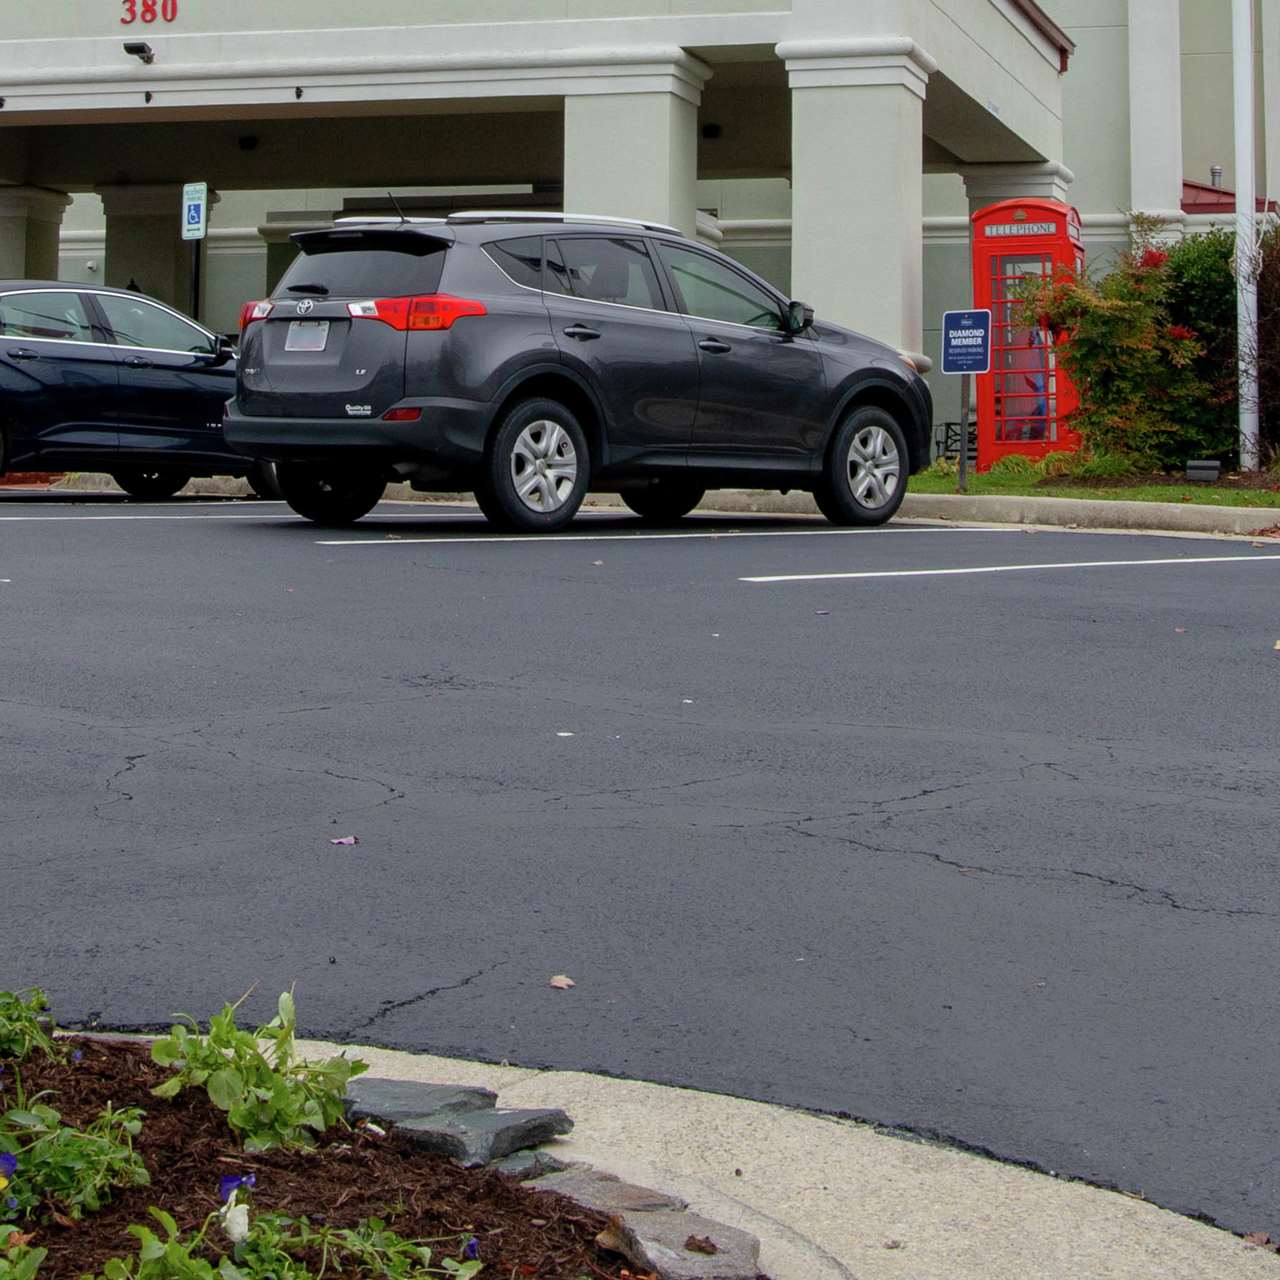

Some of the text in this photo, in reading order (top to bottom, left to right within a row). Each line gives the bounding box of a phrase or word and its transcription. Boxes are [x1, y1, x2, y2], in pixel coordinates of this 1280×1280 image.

[989, 224, 1053, 235] TELEPHONE
[949, 329, 985, 338] DIAMOND
[951, 337, 982, 346] MEMBER
